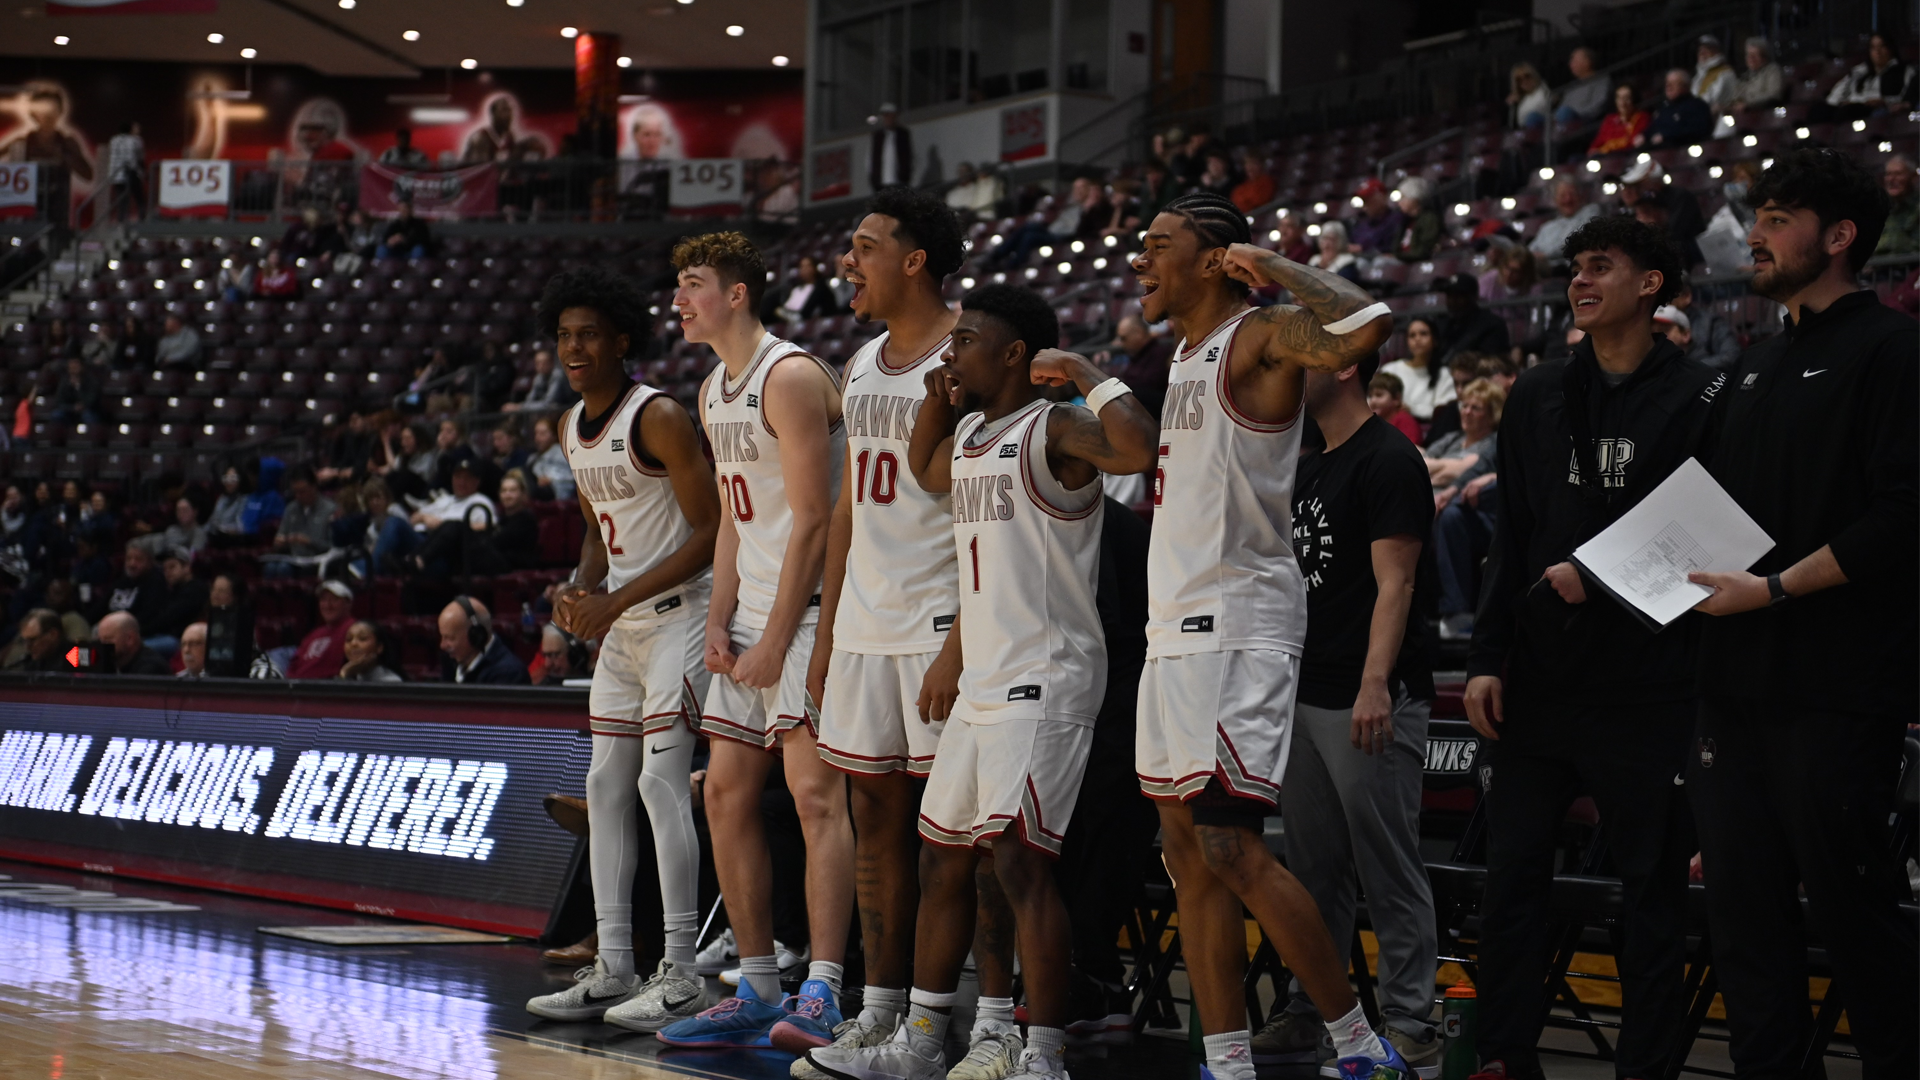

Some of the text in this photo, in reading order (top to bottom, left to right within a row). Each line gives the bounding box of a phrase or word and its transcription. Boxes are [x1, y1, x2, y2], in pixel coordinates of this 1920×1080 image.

[168, 165, 221, 192] 105
[680, 163, 735, 191] 105
[572, 465, 636, 502] AWKS
[856, 448, 900, 507] 10
[599, 511, 625, 557] 2
[969, 534, 981, 594] 1
